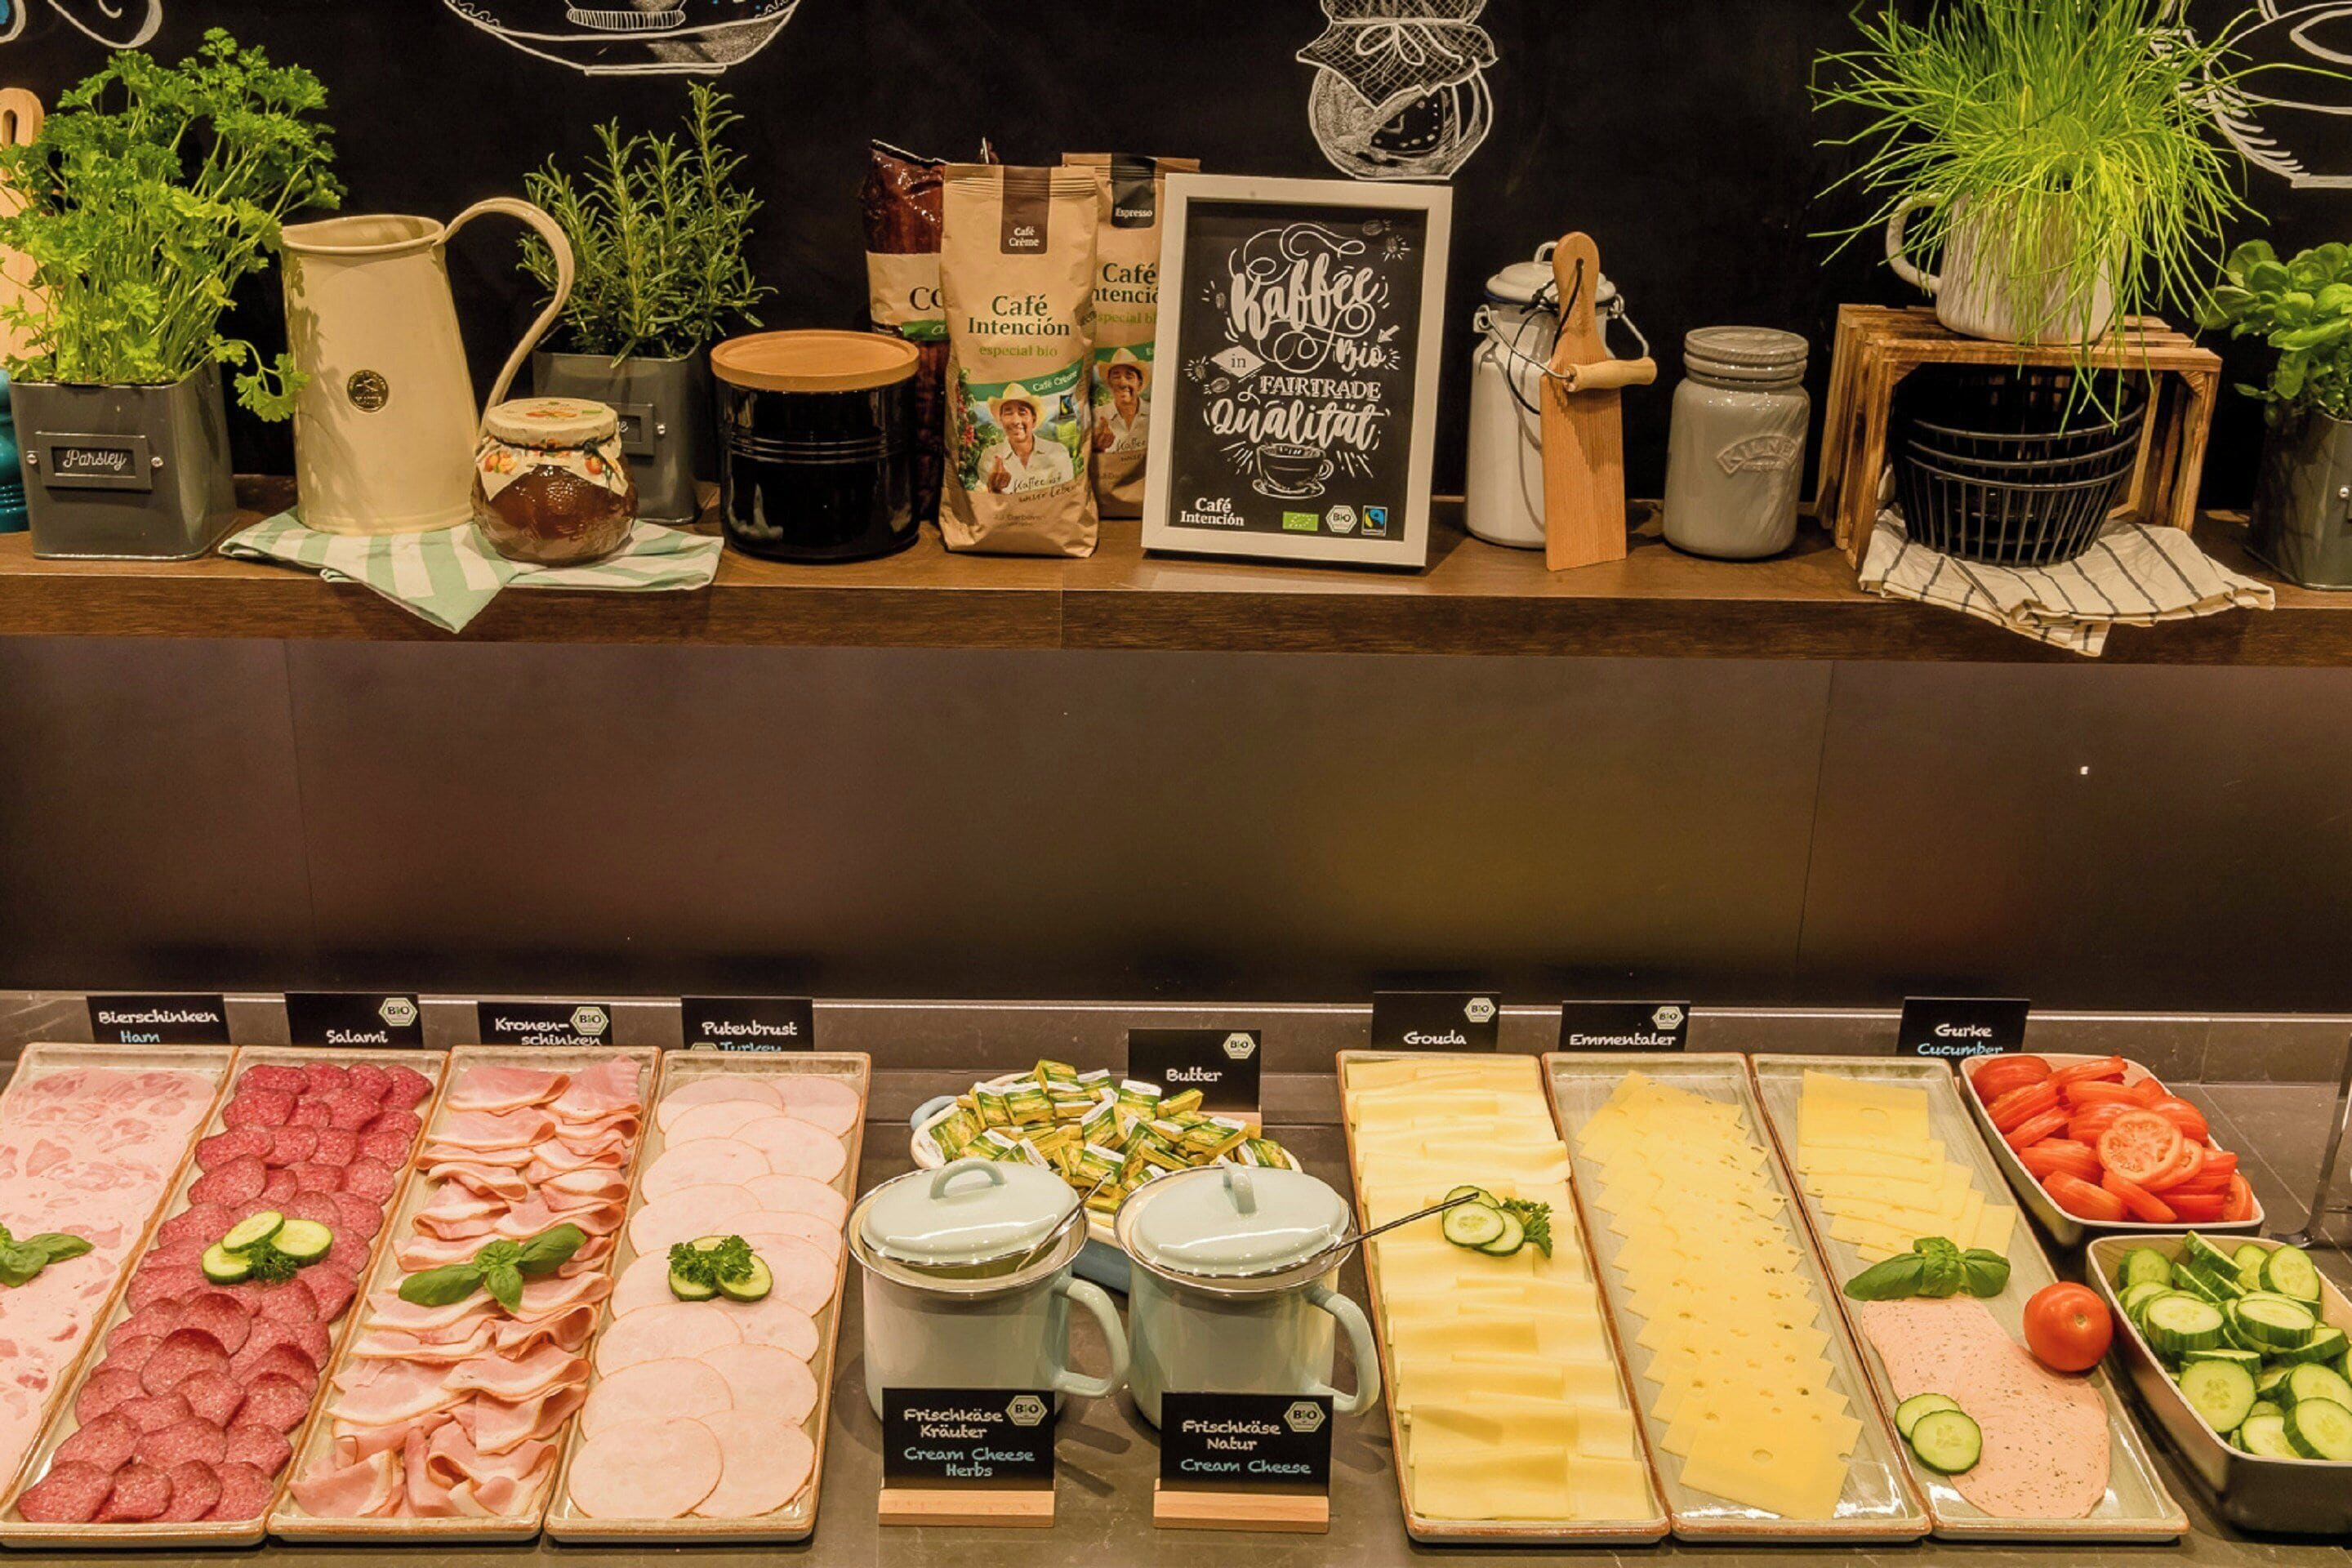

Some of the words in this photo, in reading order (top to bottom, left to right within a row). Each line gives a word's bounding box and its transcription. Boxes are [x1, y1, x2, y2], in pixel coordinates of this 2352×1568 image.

[1013, 226, 1036, 236] Café
[1102, 262, 1156, 285] Café
[1093, 287, 1159, 304] ntenci
[1231, 253, 1381, 341] Kaffee
[991, 294, 1049, 317] Café
[968, 317, 1071, 336] Intención
[1098, 312, 1143, 325] special
[979, 345, 1032, 358] especial
[1036, 345, 1058, 356] bio
[1230, 353, 1247, 368] in
[1259, 375, 1382, 402] FAIRTRADE
[1210, 398, 1386, 451] Qualität
[62, 449, 127, 471] Parsley
[1195, 497, 1232, 513] Café
[1180, 510, 1245, 527] Intención
[98, 1009, 220, 1024] Bierschinken
[494, 1016, 570, 1032] Kronen-
[701, 1019, 798, 1036] Putenbrust
[1934, 1022, 1993, 1038] Gurke
[119, 1030, 161, 1043] Ham
[326, 1029, 389, 1045] Salami
[521, 1032, 602, 1046] schinken
[1403, 1029, 1468, 1045] Gouda
[1569, 1032, 1677, 1046] Emmentaler
[1917, 1040, 2004, 1057] Cucumber
[1165, 1066, 1223, 1082] Butter
[903, 1408, 1004, 1423] Frischkäse
[920, 1424, 988, 1439] Kräuter
[1182, 1419, 1282, 1436] Frischkäse
[1206, 1436, 1258, 1451] Natur
[903, 1447, 964, 1461] Cream
[971, 1446, 1036, 1462] Cheese
[945, 1461, 994, 1477] Herbs
[1180, 1459, 1241, 1472] Cream
[1247, 1459, 1312, 1474] Cheese
